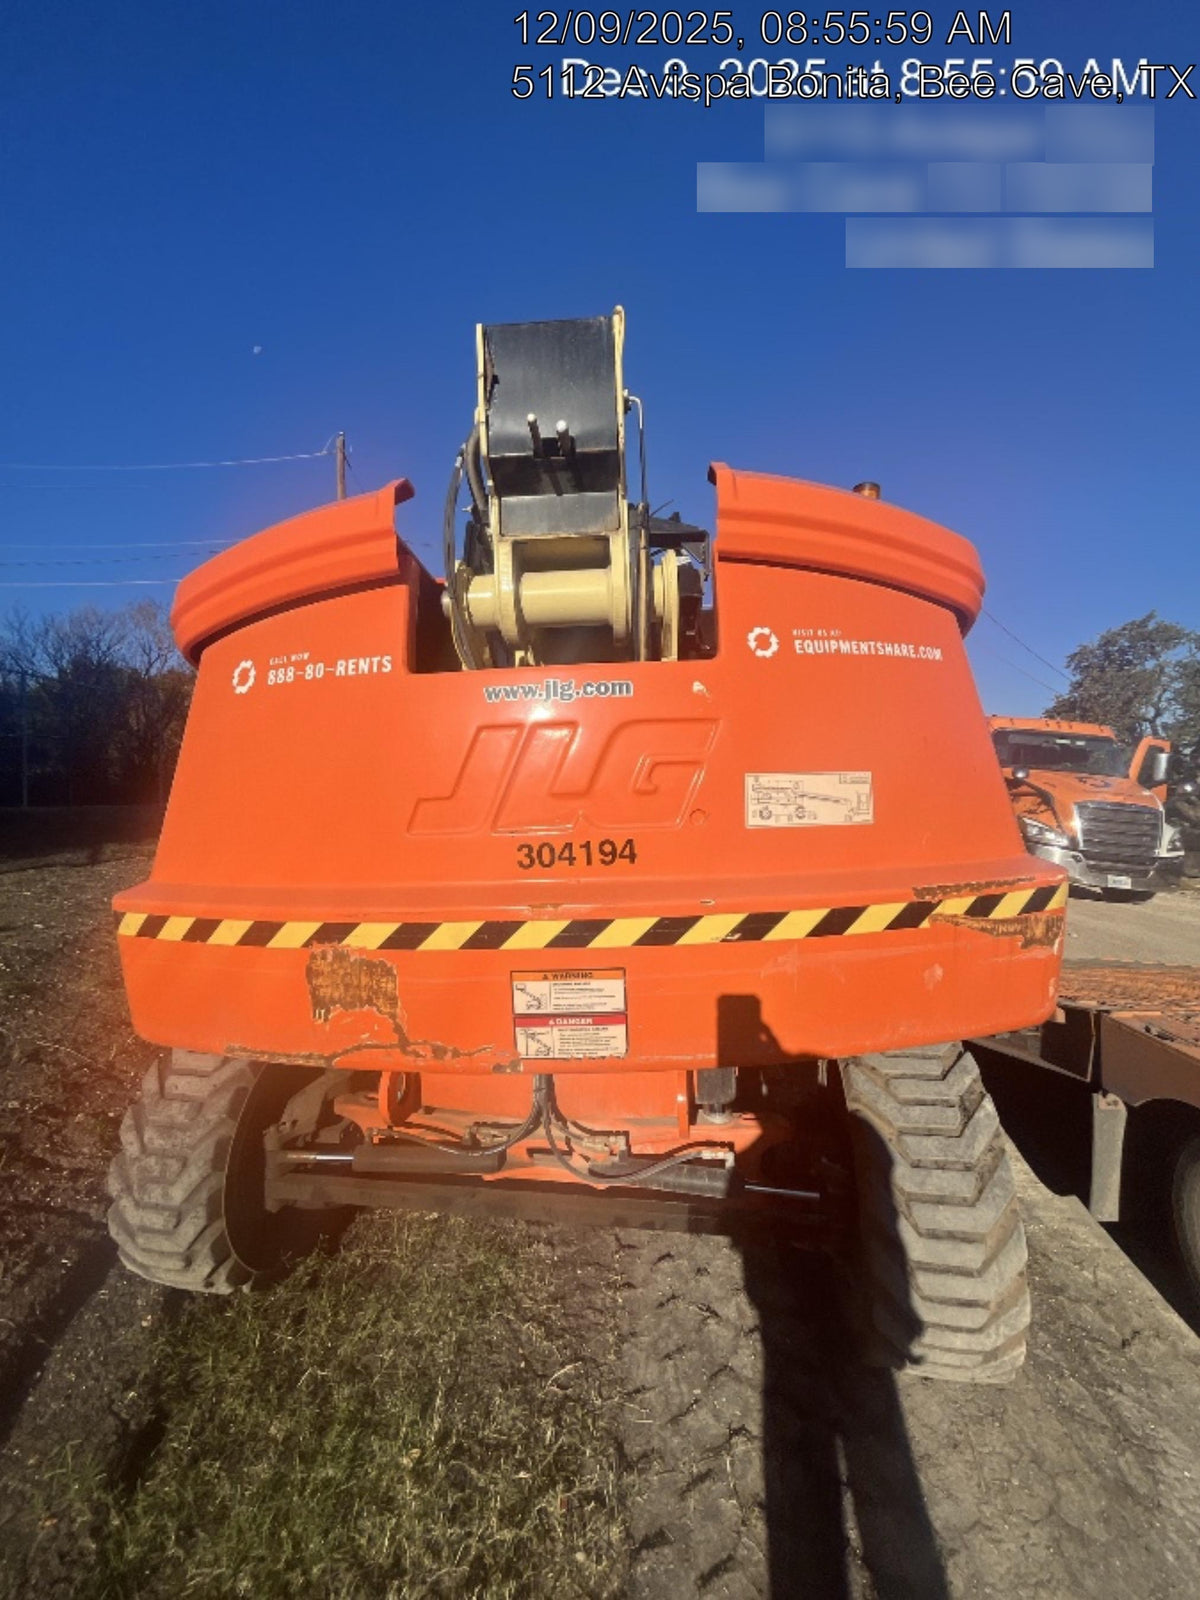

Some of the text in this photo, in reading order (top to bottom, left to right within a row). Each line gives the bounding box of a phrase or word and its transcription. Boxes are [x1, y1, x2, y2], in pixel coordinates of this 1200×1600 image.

[794, 639, 943, 661] EQUIPMENTSHARE.COM
[267, 655, 392, 685] 888-80-RENTS
[484, 678, 633, 703] www.jlg.com
[407, 718, 722, 836] JLG
[516, 839, 637, 870] 304194
